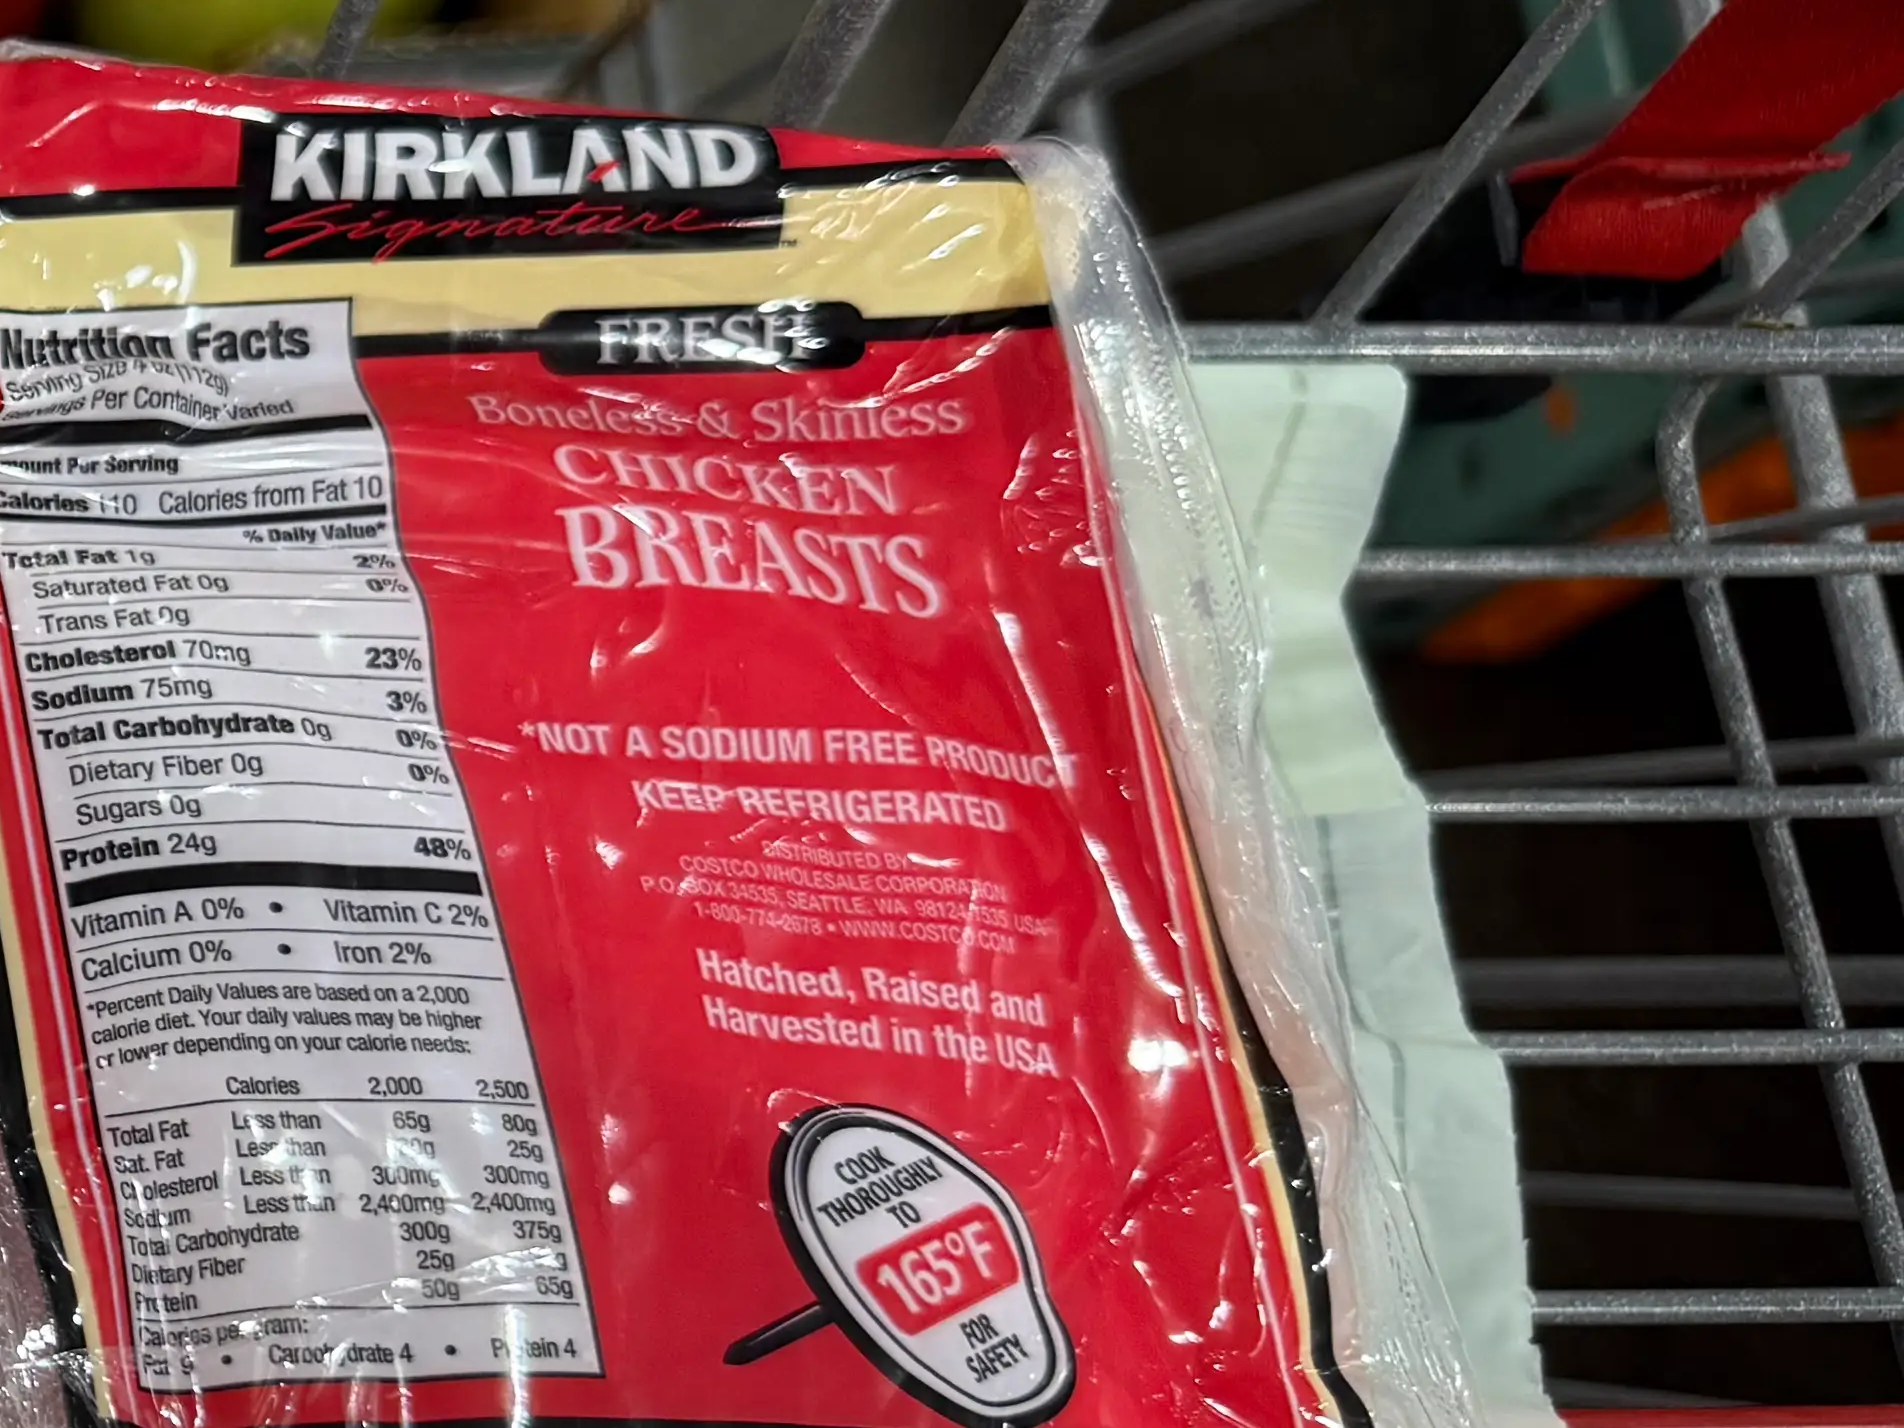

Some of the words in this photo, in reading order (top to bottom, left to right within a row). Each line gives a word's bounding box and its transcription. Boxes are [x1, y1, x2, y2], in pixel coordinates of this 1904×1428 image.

[270, 123, 761, 203] KIRKLAND
[264, 200, 778, 264] Signature
[0, 326, 177, 370] Nutrition
[187, 320, 311, 362] Facts
[595, 313, 810, 364] FRESH
[468, 394, 682, 436] Boneless
[696, 404, 740, 440] &
[753, 396, 973, 443] Skinless
[553, 445, 900, 516] CHICKEN
[557, 504, 946, 620] BREASTS
[695, 947, 856, 1003] Hatched,
[864, 966, 980, 1013] Raised
[991, 988, 1047, 1028] and
[703, 994, 882, 1050] Harvested
[892, 1018, 924, 1054] in
[934, 1023, 988, 1063] the
[996, 1037, 1058, 1075] USA
[816, 1156, 943, 1228] THOROUGHLY
[834, 1145, 895, 1185] COOK
[885, 1201, 922, 1228] TO
[876, 1220, 993, 1315] 165°F
[960, 1313, 999, 1349] FOR
[965, 1333, 1030, 1383] SAFETY
